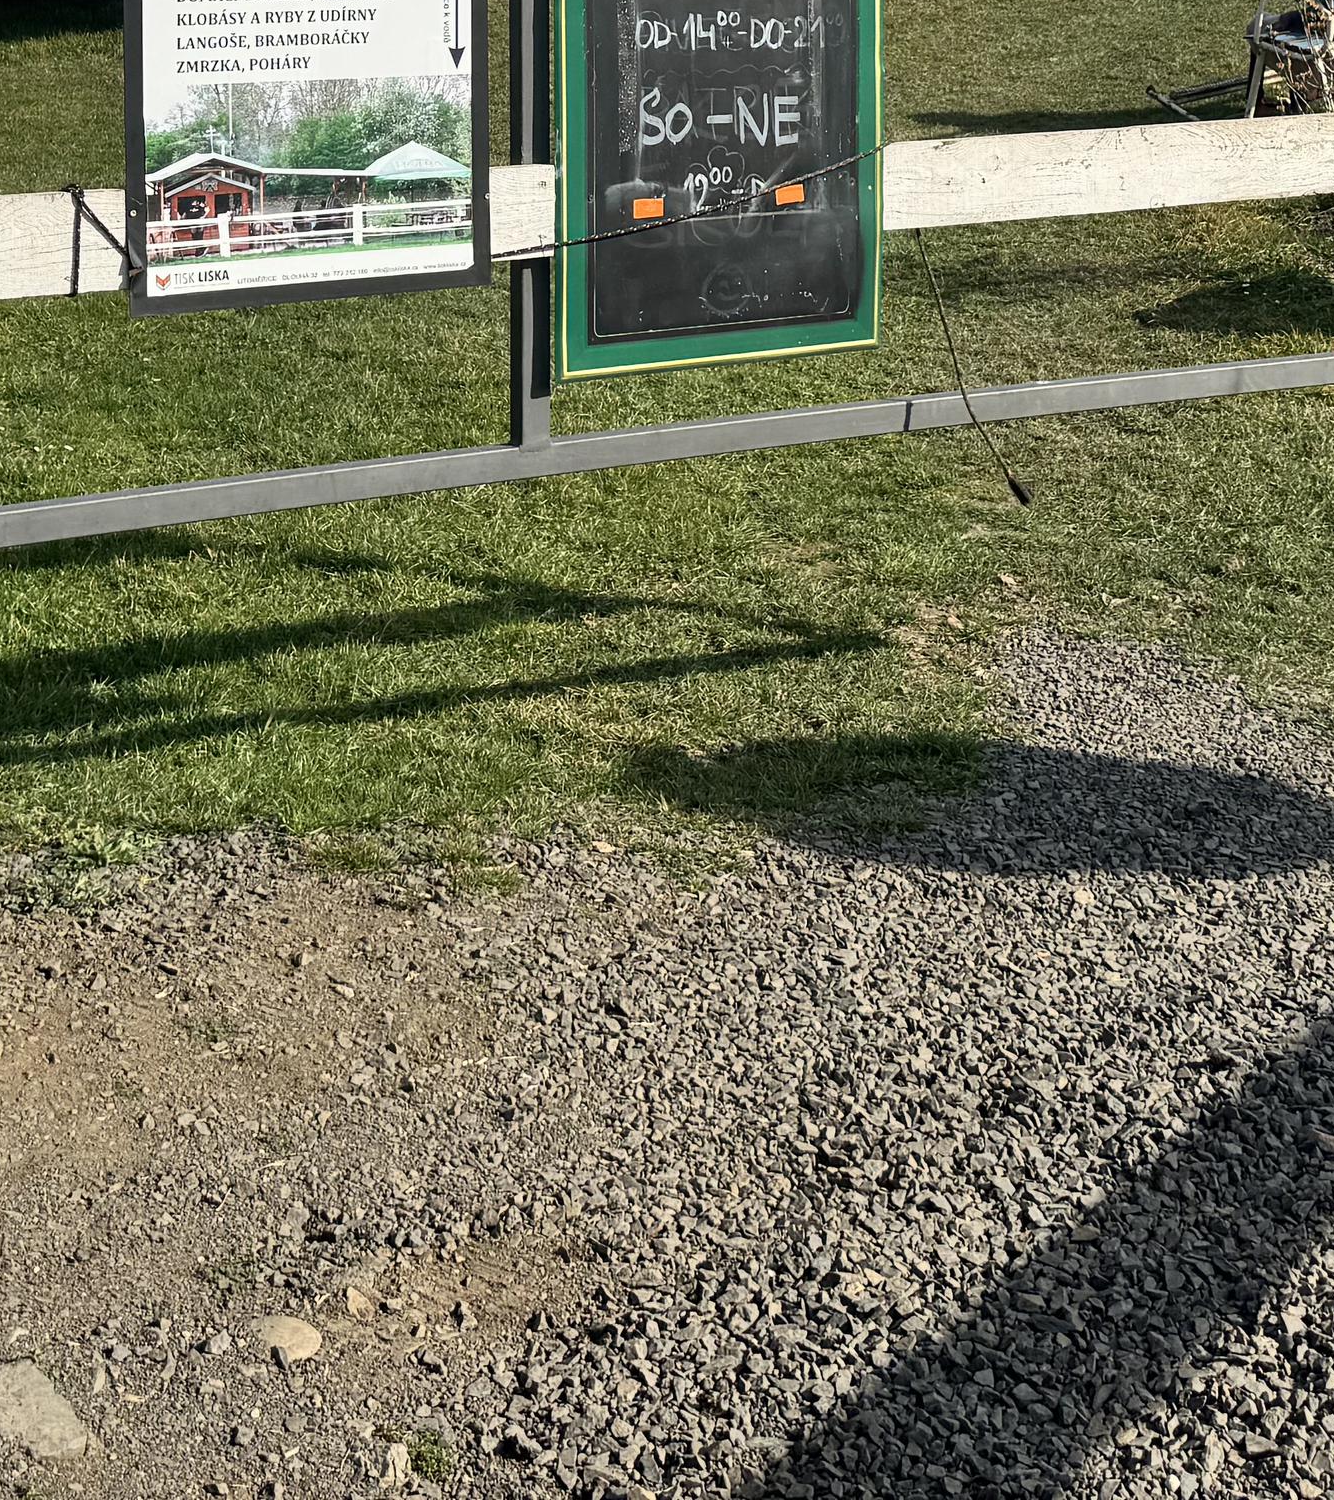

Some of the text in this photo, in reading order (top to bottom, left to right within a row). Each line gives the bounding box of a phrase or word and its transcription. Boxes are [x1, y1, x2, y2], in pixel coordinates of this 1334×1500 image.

[177, 4, 377, 27] KLOBÁSY A RYBY Z UDÍRNY
[177, 30, 370, 50] LANGOŠE, BRAMBORÁČKY
[176, 54, 311, 74] ZMRZKA, POHÁRY
[174, 270, 230, 285] TISK LISKA
